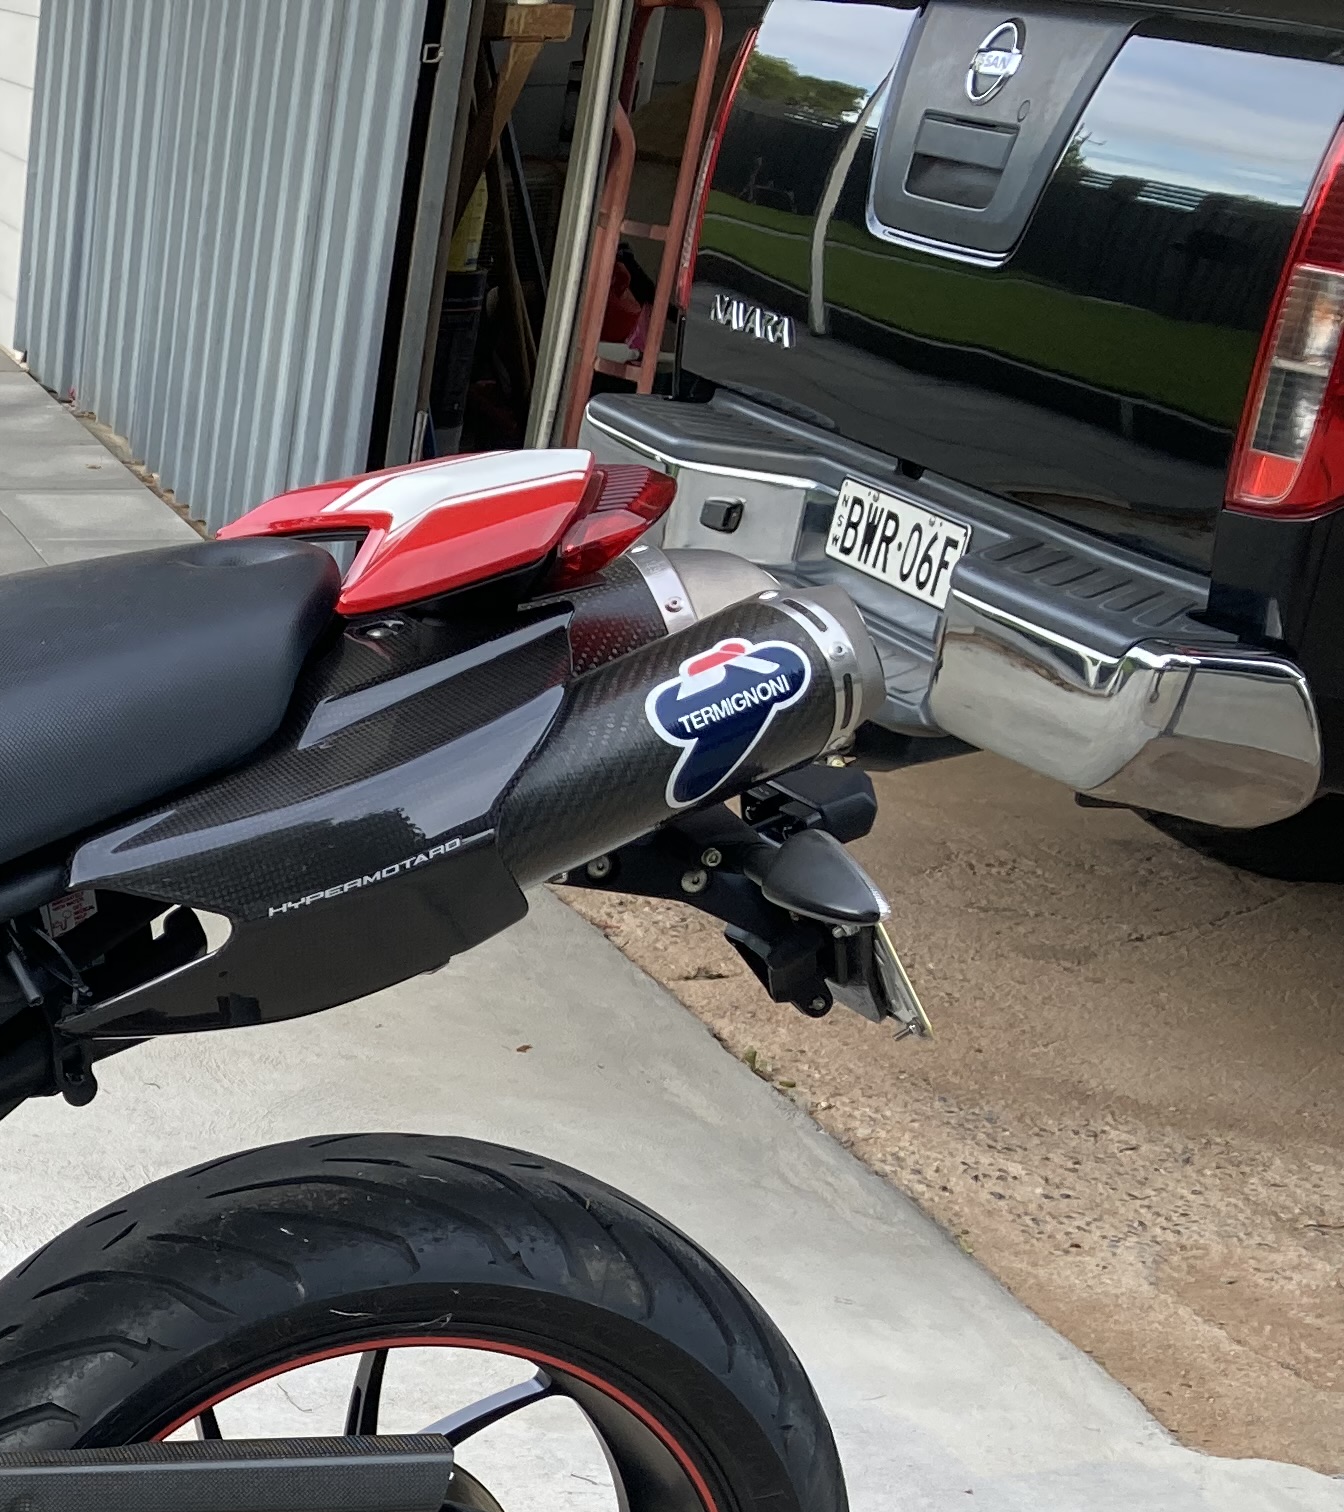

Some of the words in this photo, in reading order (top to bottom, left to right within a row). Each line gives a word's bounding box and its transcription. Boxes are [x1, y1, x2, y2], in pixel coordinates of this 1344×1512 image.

[710, 294, 796, 348] NAVARA
[678, 674, 791, 733] TERMIGNONI
[268, 837, 461, 917] HYPERMOTARD
